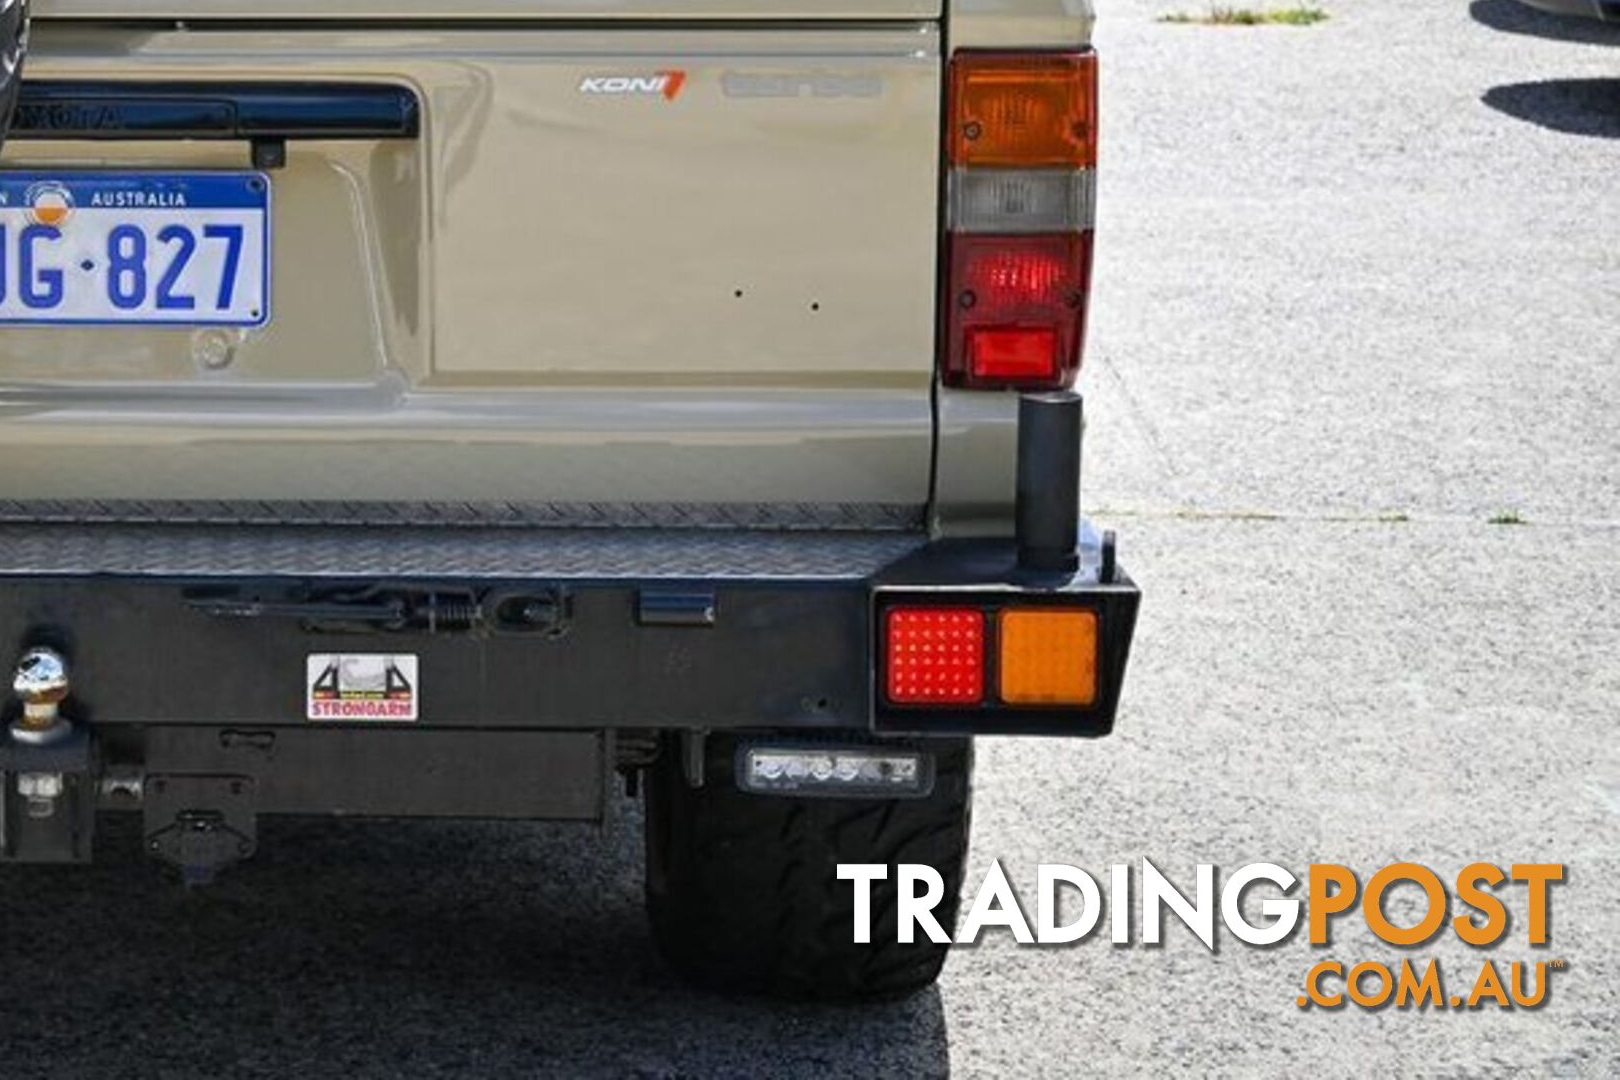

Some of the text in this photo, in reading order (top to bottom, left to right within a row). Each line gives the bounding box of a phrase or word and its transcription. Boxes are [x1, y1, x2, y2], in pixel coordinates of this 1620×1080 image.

[579, 75, 671, 93] KONI
[91, 192, 186, 207] AUSTRALIA
[312, 702, 413, 717] STRONGARM
